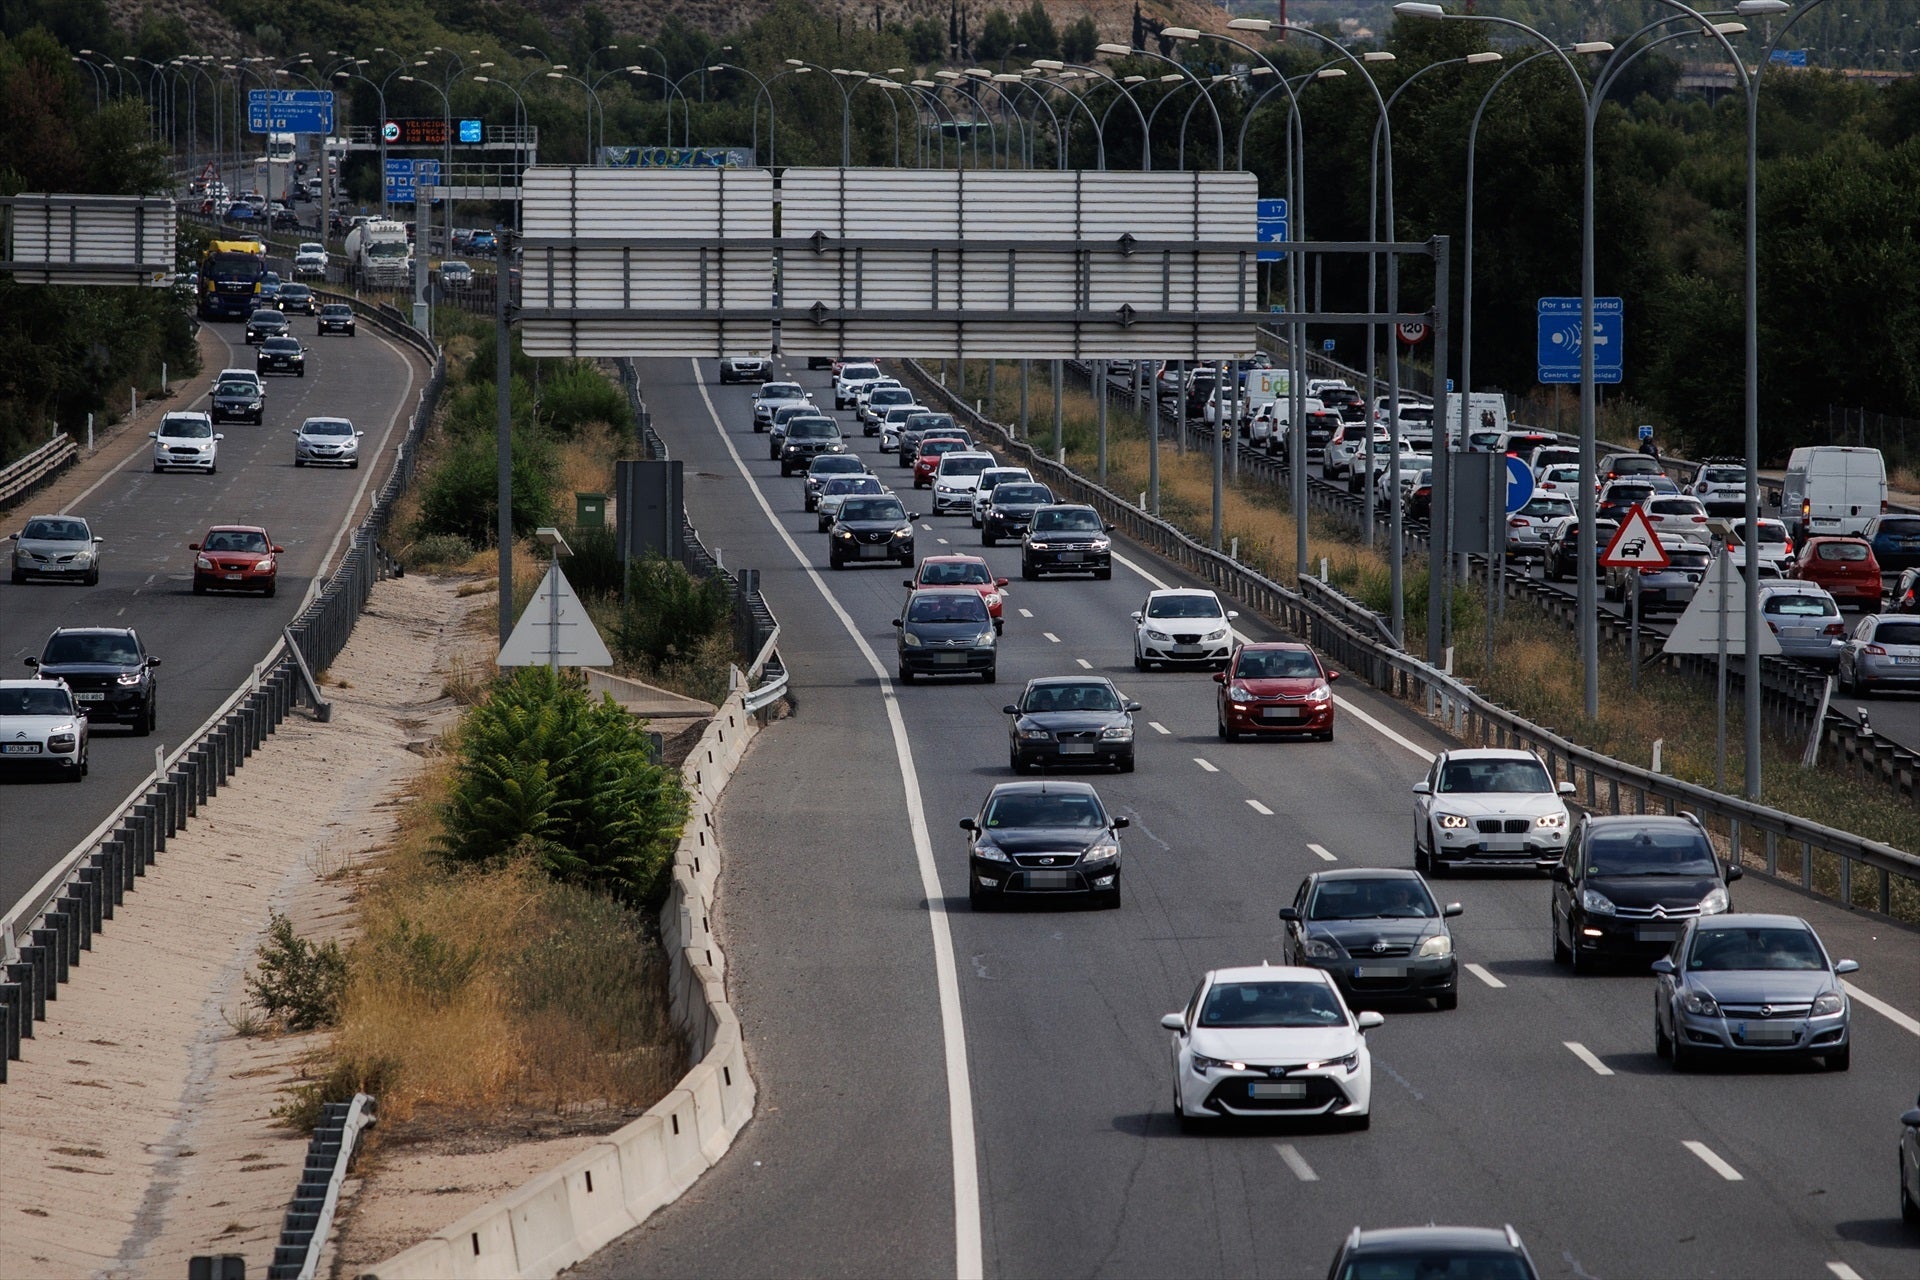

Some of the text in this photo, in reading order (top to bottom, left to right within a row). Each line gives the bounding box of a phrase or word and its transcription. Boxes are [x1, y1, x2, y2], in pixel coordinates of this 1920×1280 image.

[1272, 205, 1282, 213] 17
[1542, 301, 1556, 309] Por
[1402, 322, 1422, 333] 120
